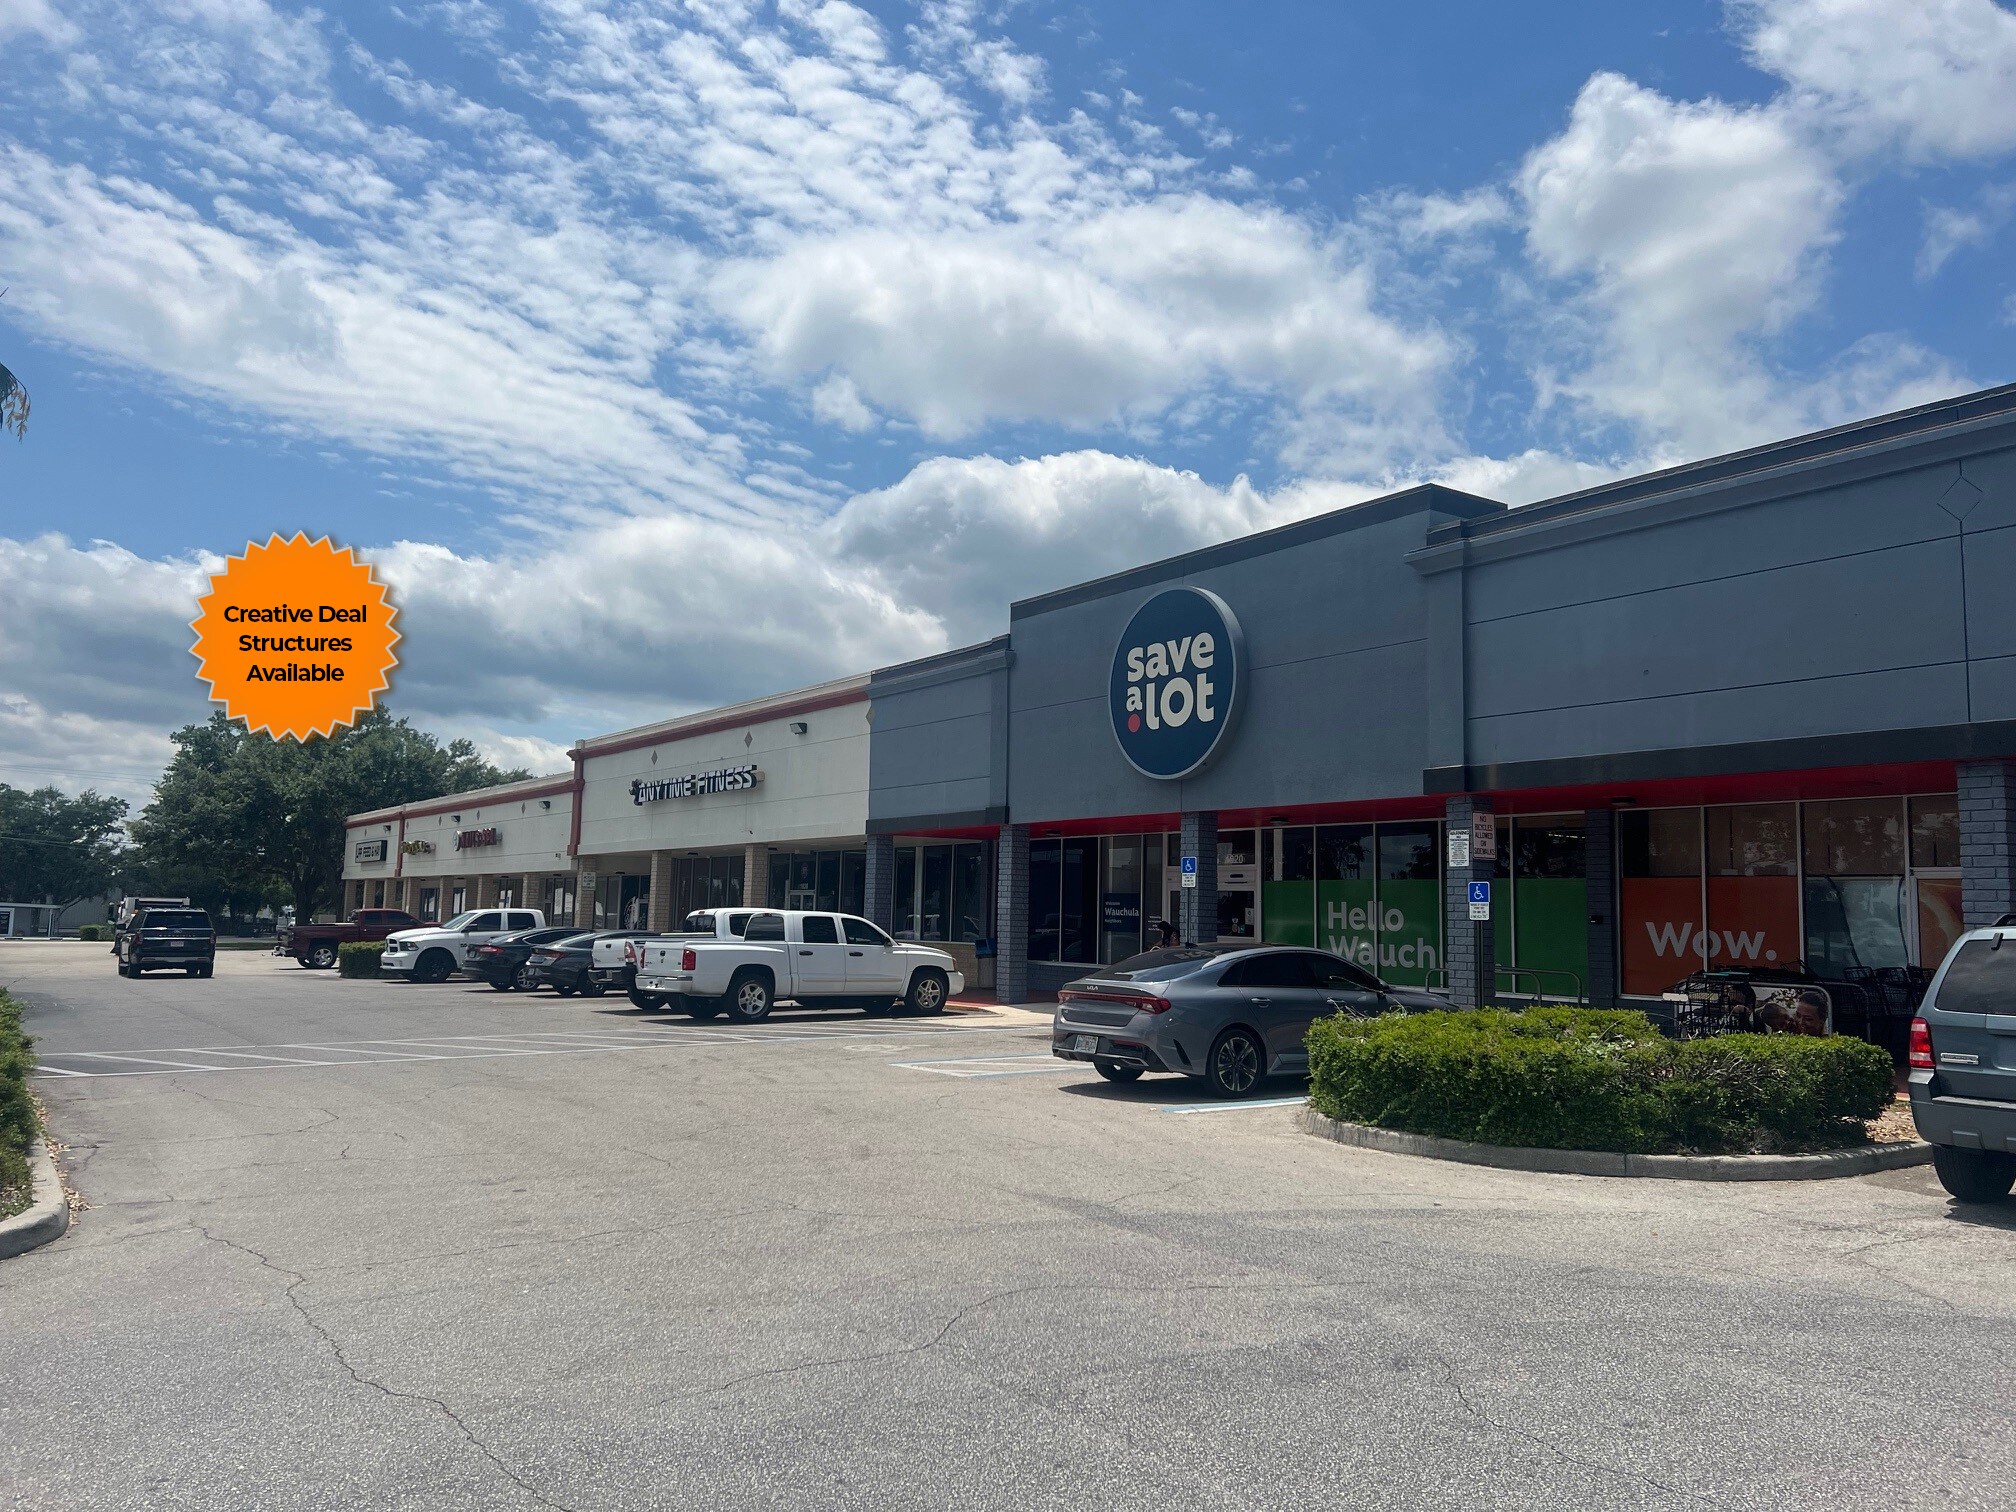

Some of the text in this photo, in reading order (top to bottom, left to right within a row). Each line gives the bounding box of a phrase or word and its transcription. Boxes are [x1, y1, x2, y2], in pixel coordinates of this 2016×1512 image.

[1127, 632, 1215, 682] save
[1126, 686, 1143, 712] a
[638, 765, 754, 802] ANYTIME FITNESS
[1474, 847, 1496, 855] SIDEWALKS
[1104, 907, 1140, 917] Wauchula
[1327, 901, 1404, 932] Hello
[1645, 921, 1777, 961] Wow.
